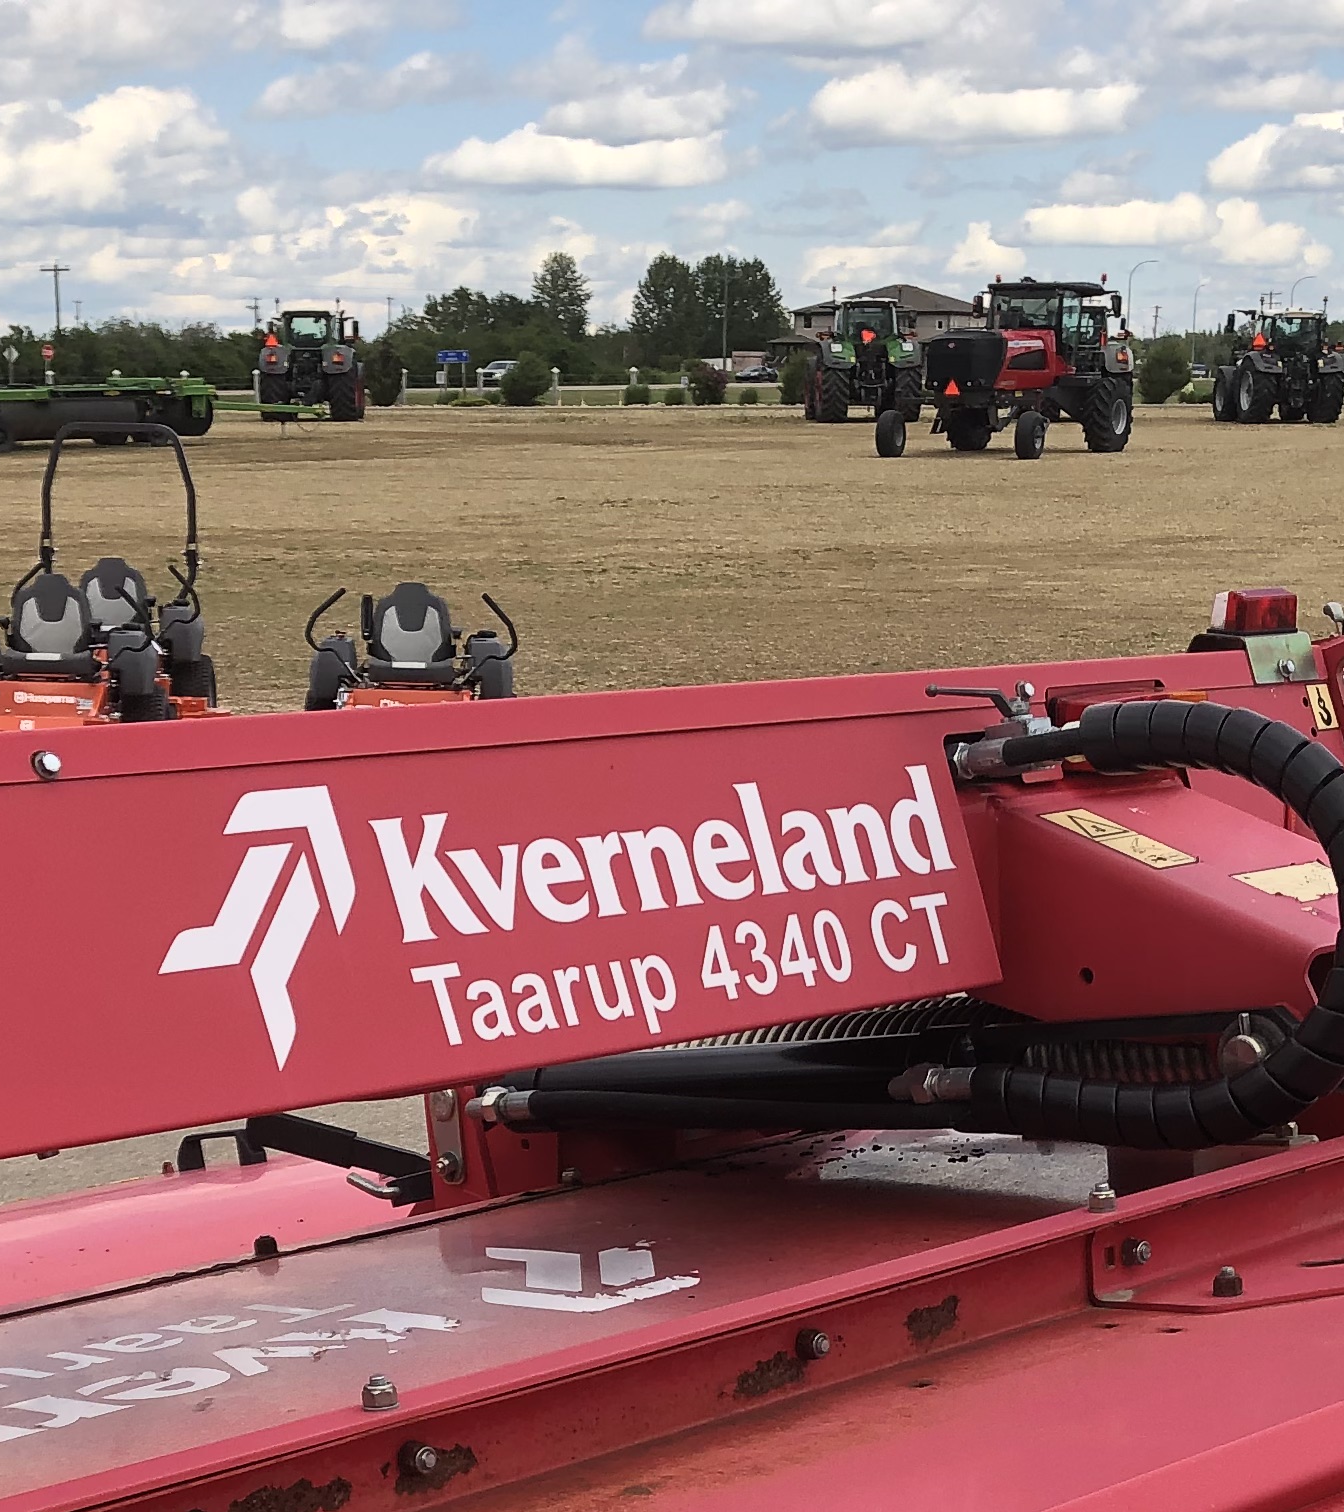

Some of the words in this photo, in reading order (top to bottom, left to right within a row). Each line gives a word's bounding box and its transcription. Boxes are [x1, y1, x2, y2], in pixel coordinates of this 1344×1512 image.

[367, 764, 957, 944] Kverneland
[410, 952, 677, 1046] Taarup
[700, 909, 853, 1001] 4340
[870, 892, 950, 973] CT
